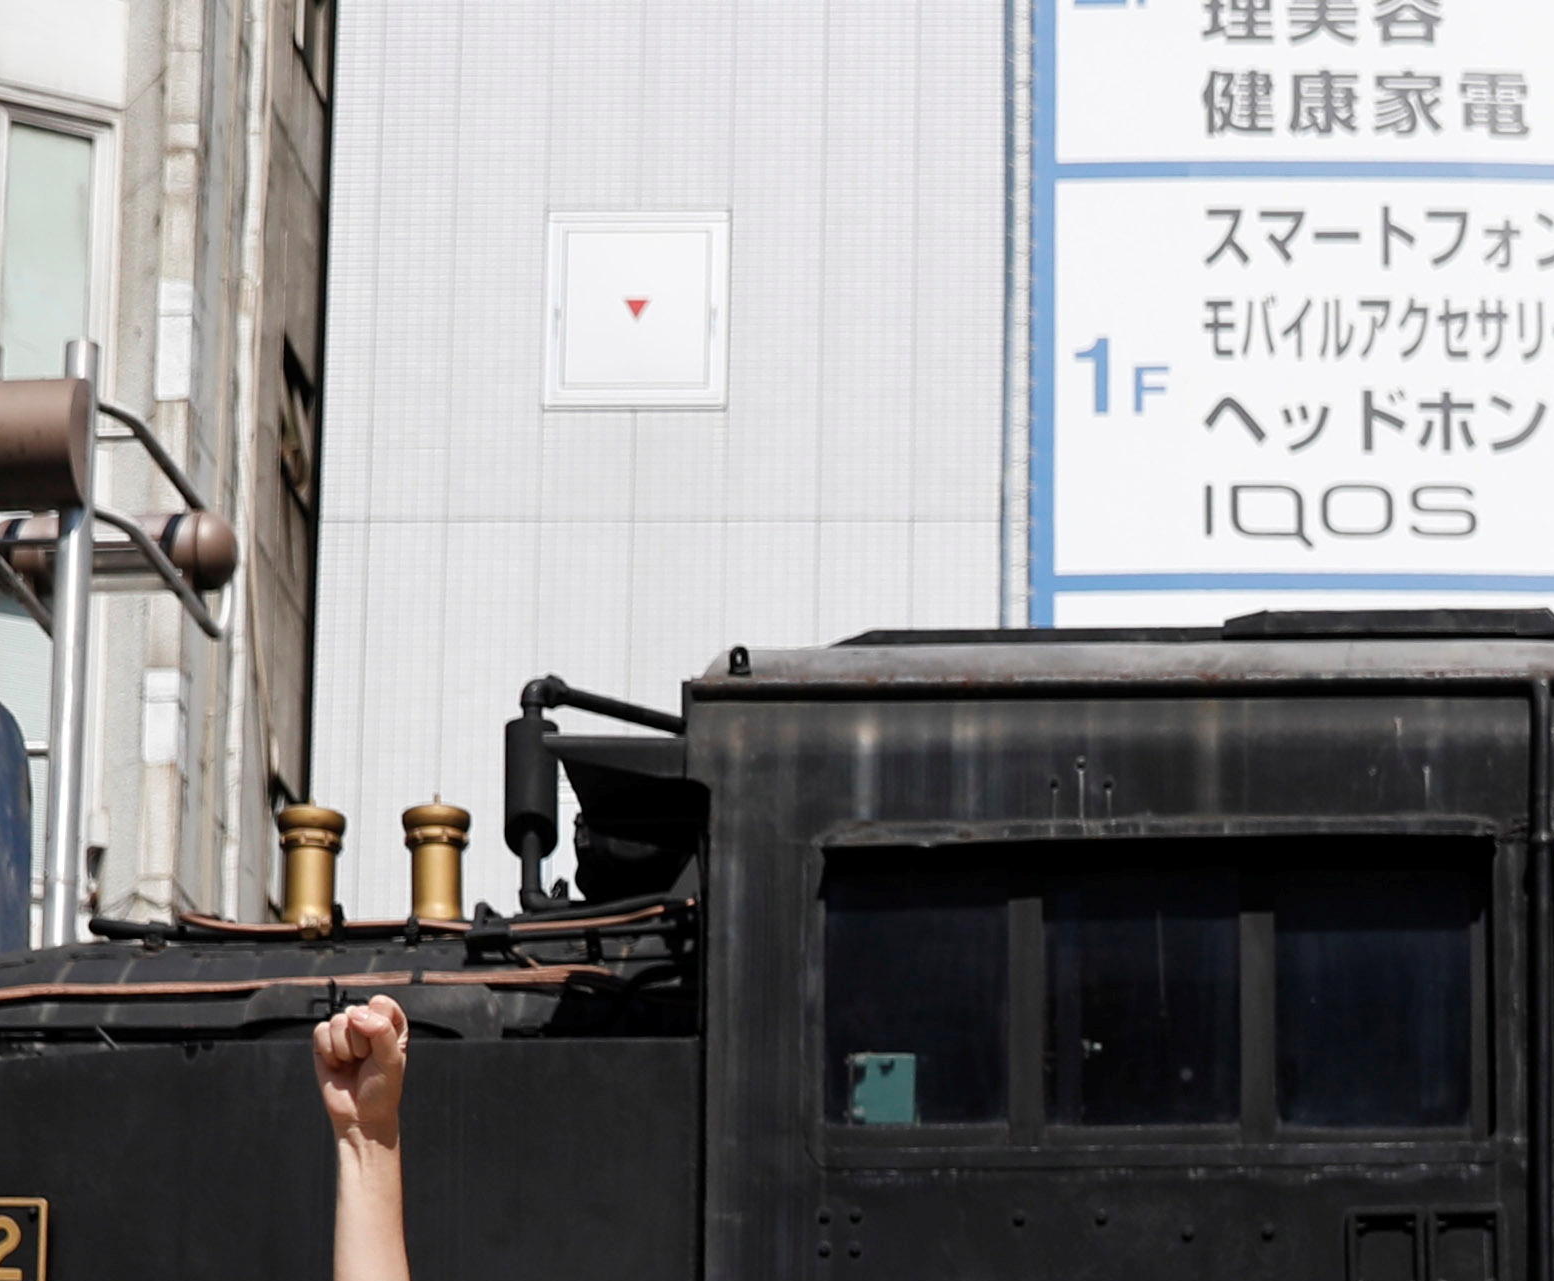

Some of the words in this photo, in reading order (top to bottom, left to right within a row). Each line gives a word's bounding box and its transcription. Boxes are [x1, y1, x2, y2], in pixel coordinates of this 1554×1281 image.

[1201, 0, 1444, 46] 理美容
[1202, 69, 1530, 137] 健康家電
[1074, 337, 1170, 416] 1F
[1204, 389, 1548, 452] ヘッドホン
[1203, 483, 1478, 550] IQOS
